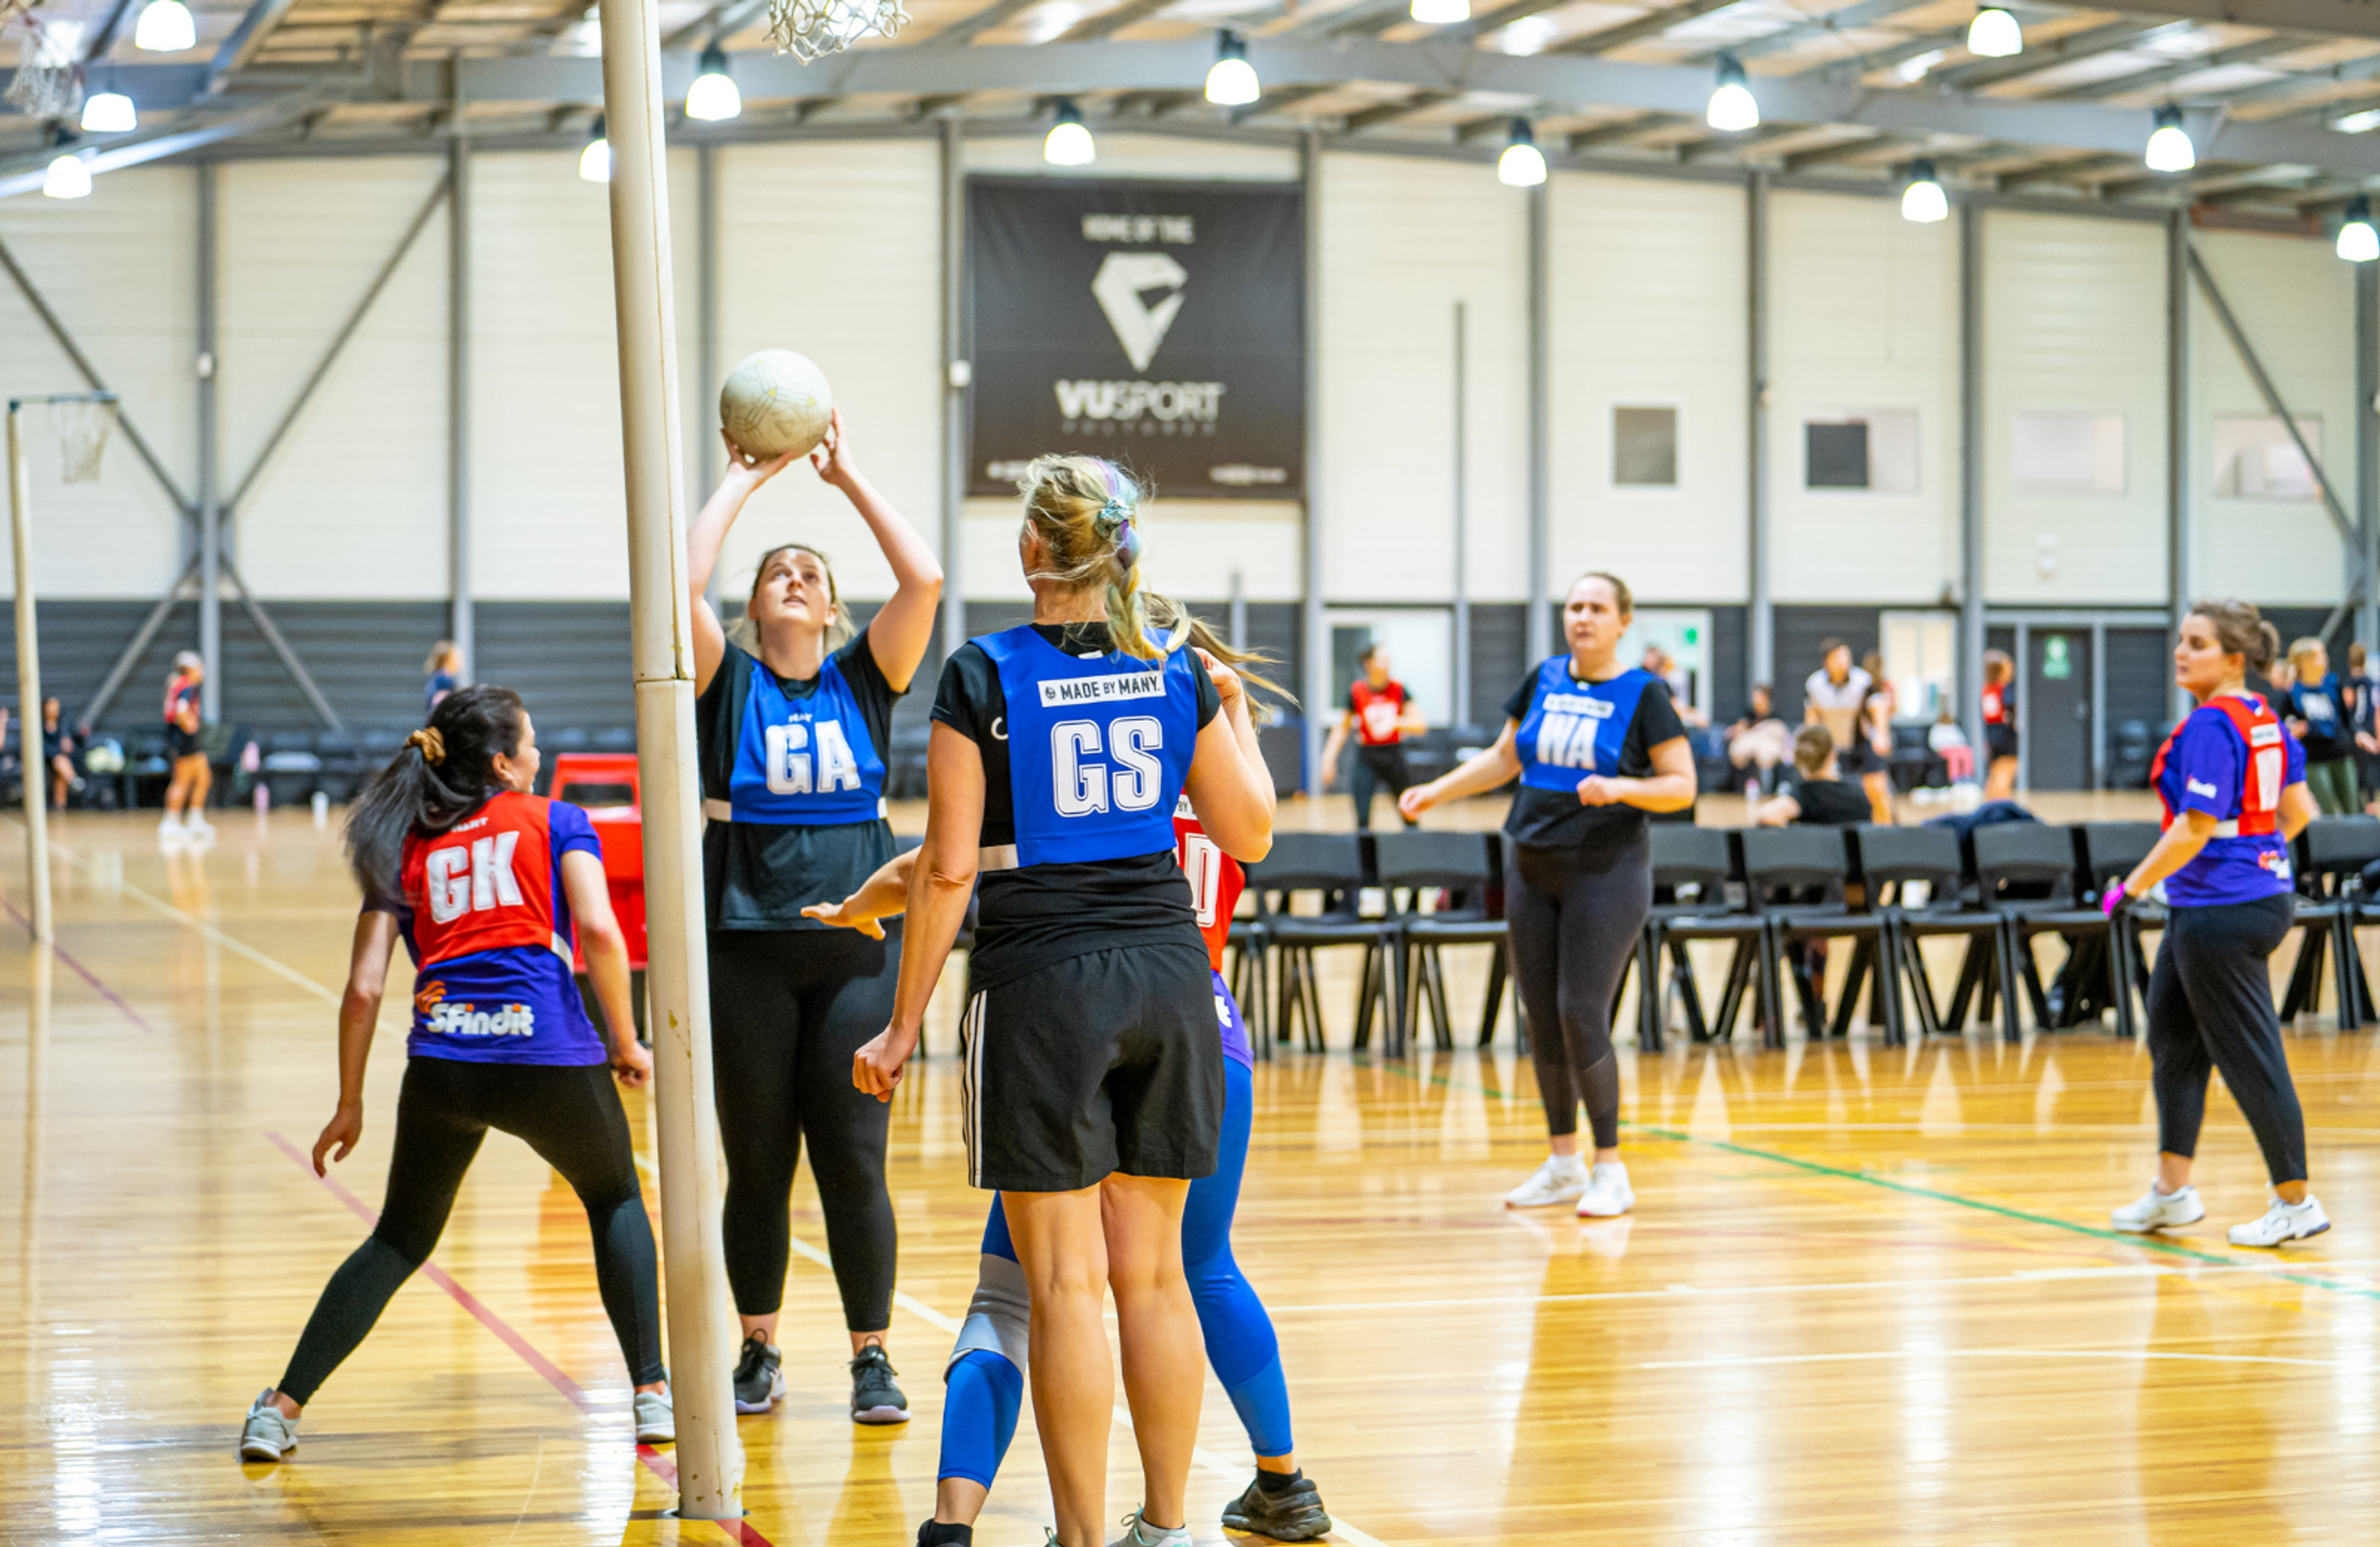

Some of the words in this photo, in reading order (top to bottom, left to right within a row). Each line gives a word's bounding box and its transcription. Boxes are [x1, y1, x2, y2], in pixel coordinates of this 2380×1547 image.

[1055, 379, 1226, 421] VUSPORT
[1060, 681, 1100, 701] MADE
[1104, 681, 1115, 694] BY
[766, 720, 862, 795] GA
[1050, 716, 1164, 818] GS
[1537, 712, 1599, 770] WA
[425, 830, 524, 925] GK
